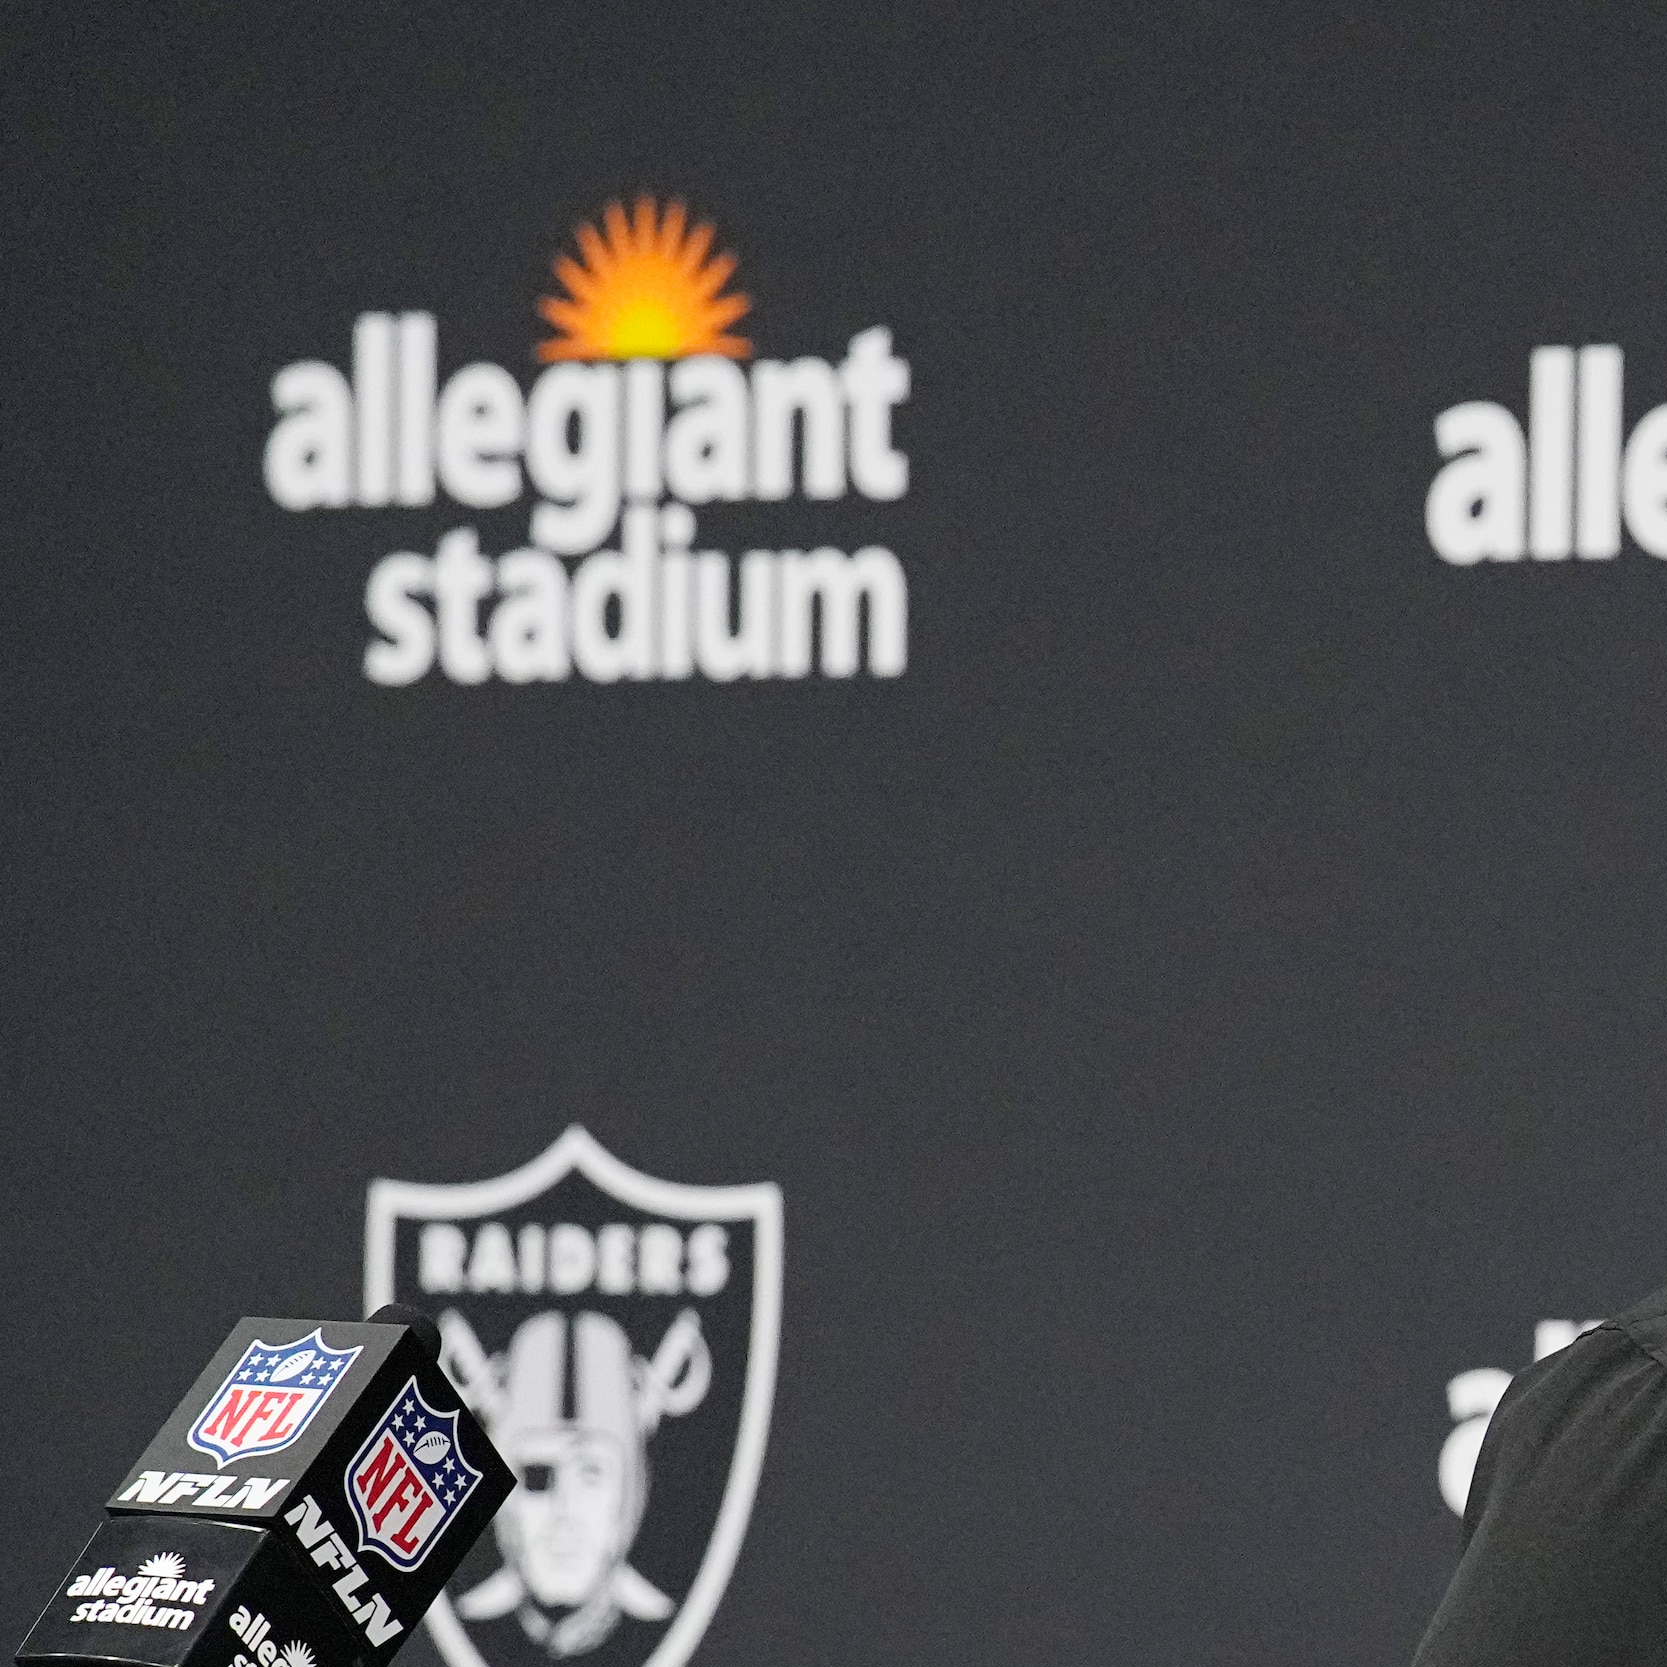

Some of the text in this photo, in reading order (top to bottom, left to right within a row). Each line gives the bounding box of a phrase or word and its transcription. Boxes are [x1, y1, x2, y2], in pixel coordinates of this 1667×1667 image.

[264, 310, 911, 555] allegiant
[361, 502, 908, 686] stadium
[418, 1222, 731, 1297] RAIDERS
[203, 1384, 301, 1447] NFL
[116, 1470, 290, 1509] NFLN
[356, 1437, 433, 1555] NFL
[66, 1566, 215, 1605] allegiant
[284, 1495, 404, 1648] NFLN
[70, 1598, 195, 1631] stadium
